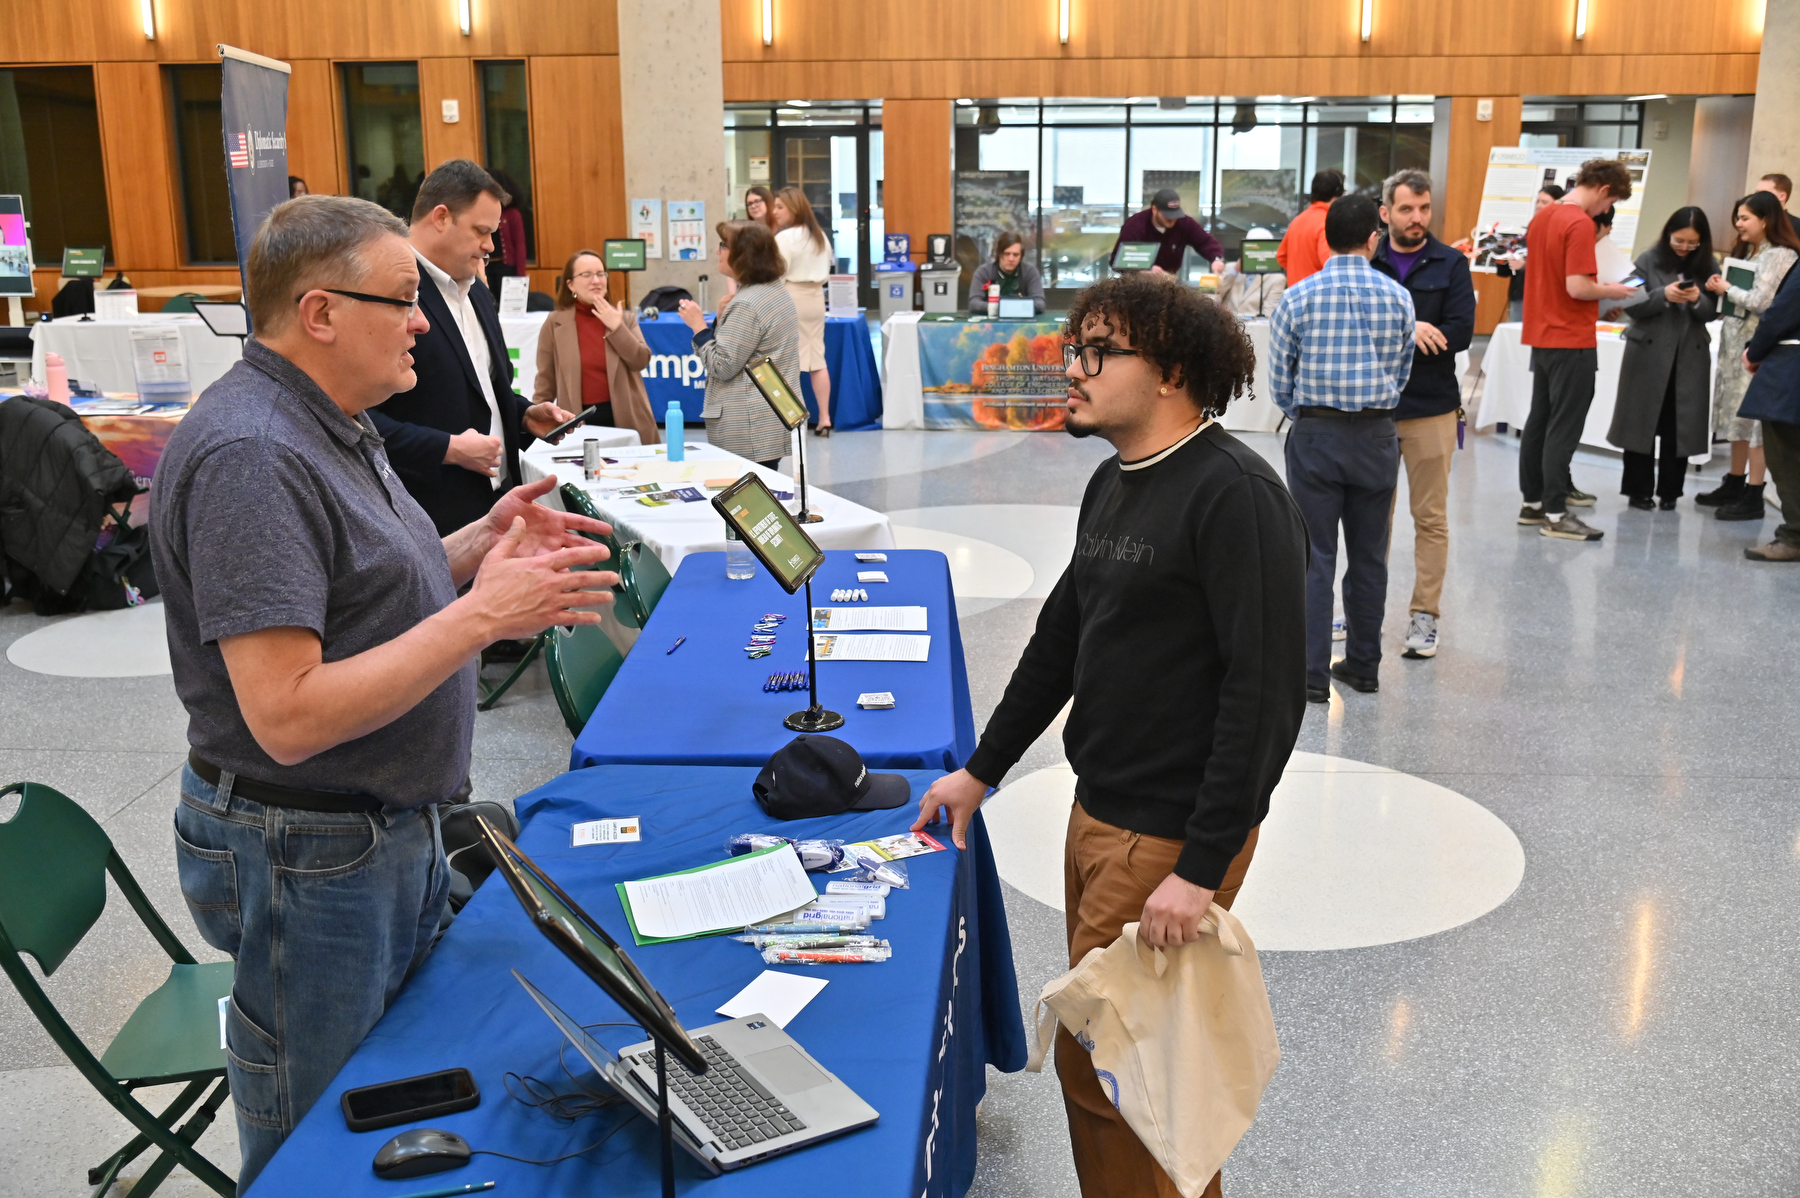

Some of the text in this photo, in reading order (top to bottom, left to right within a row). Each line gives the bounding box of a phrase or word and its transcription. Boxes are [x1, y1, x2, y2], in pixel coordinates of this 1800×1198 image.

[254, 130, 285, 156] Diplomatic Security
[1032, 363, 1067, 371] UNIVERS
[1077, 532, 1154, 566] Calvin Klein
[803, 912, 854, 921] nationalgrid
